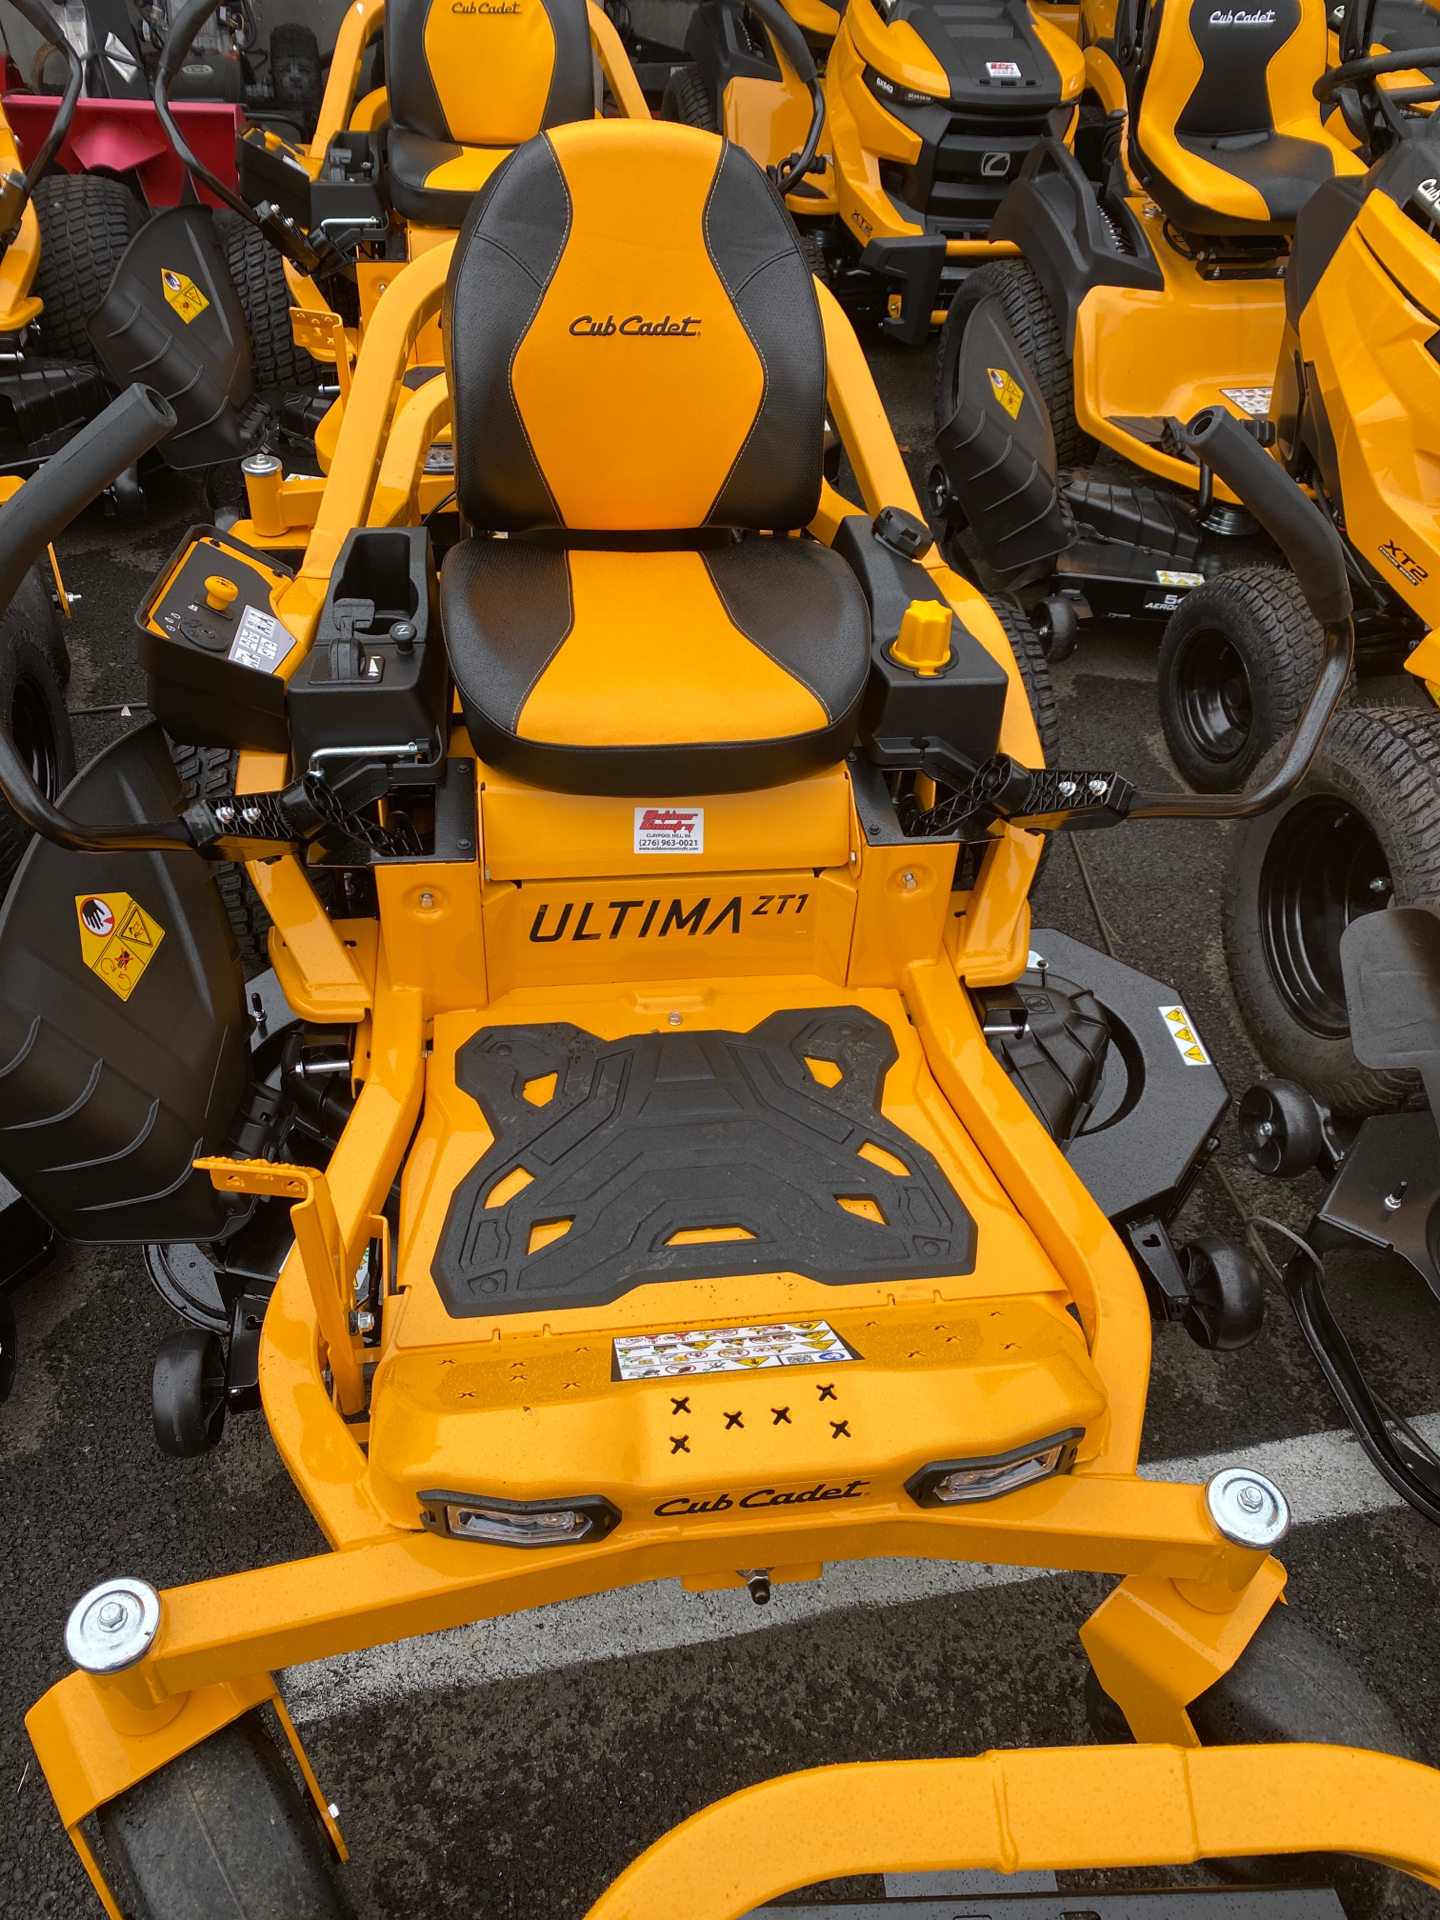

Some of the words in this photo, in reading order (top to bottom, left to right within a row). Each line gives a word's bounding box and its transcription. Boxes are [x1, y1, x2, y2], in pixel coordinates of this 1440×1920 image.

[451, 1, 477, 14] Cub
[478, 1, 521, 14] Cadet
[1209, 10, 1233, 23] Cub
[1234, 9, 1276, 23] Cadet
[568, 314, 617, 336] Cub
[618, 314, 702, 336] Cadet
[1382, 538, 1429, 583] XT2
[642, 810, 698, 824] Outdoor
[639, 819, 695, 834] Country
[639, 839, 660, 847] (276)
[661, 839, 698, 847] 963-0021
[529, 896, 742, 943] ULTIMA
[751, 893, 809, 915] ZT1
[653, 1493, 734, 1516] Cub
[738, 1480, 871, 1508] Cadet
